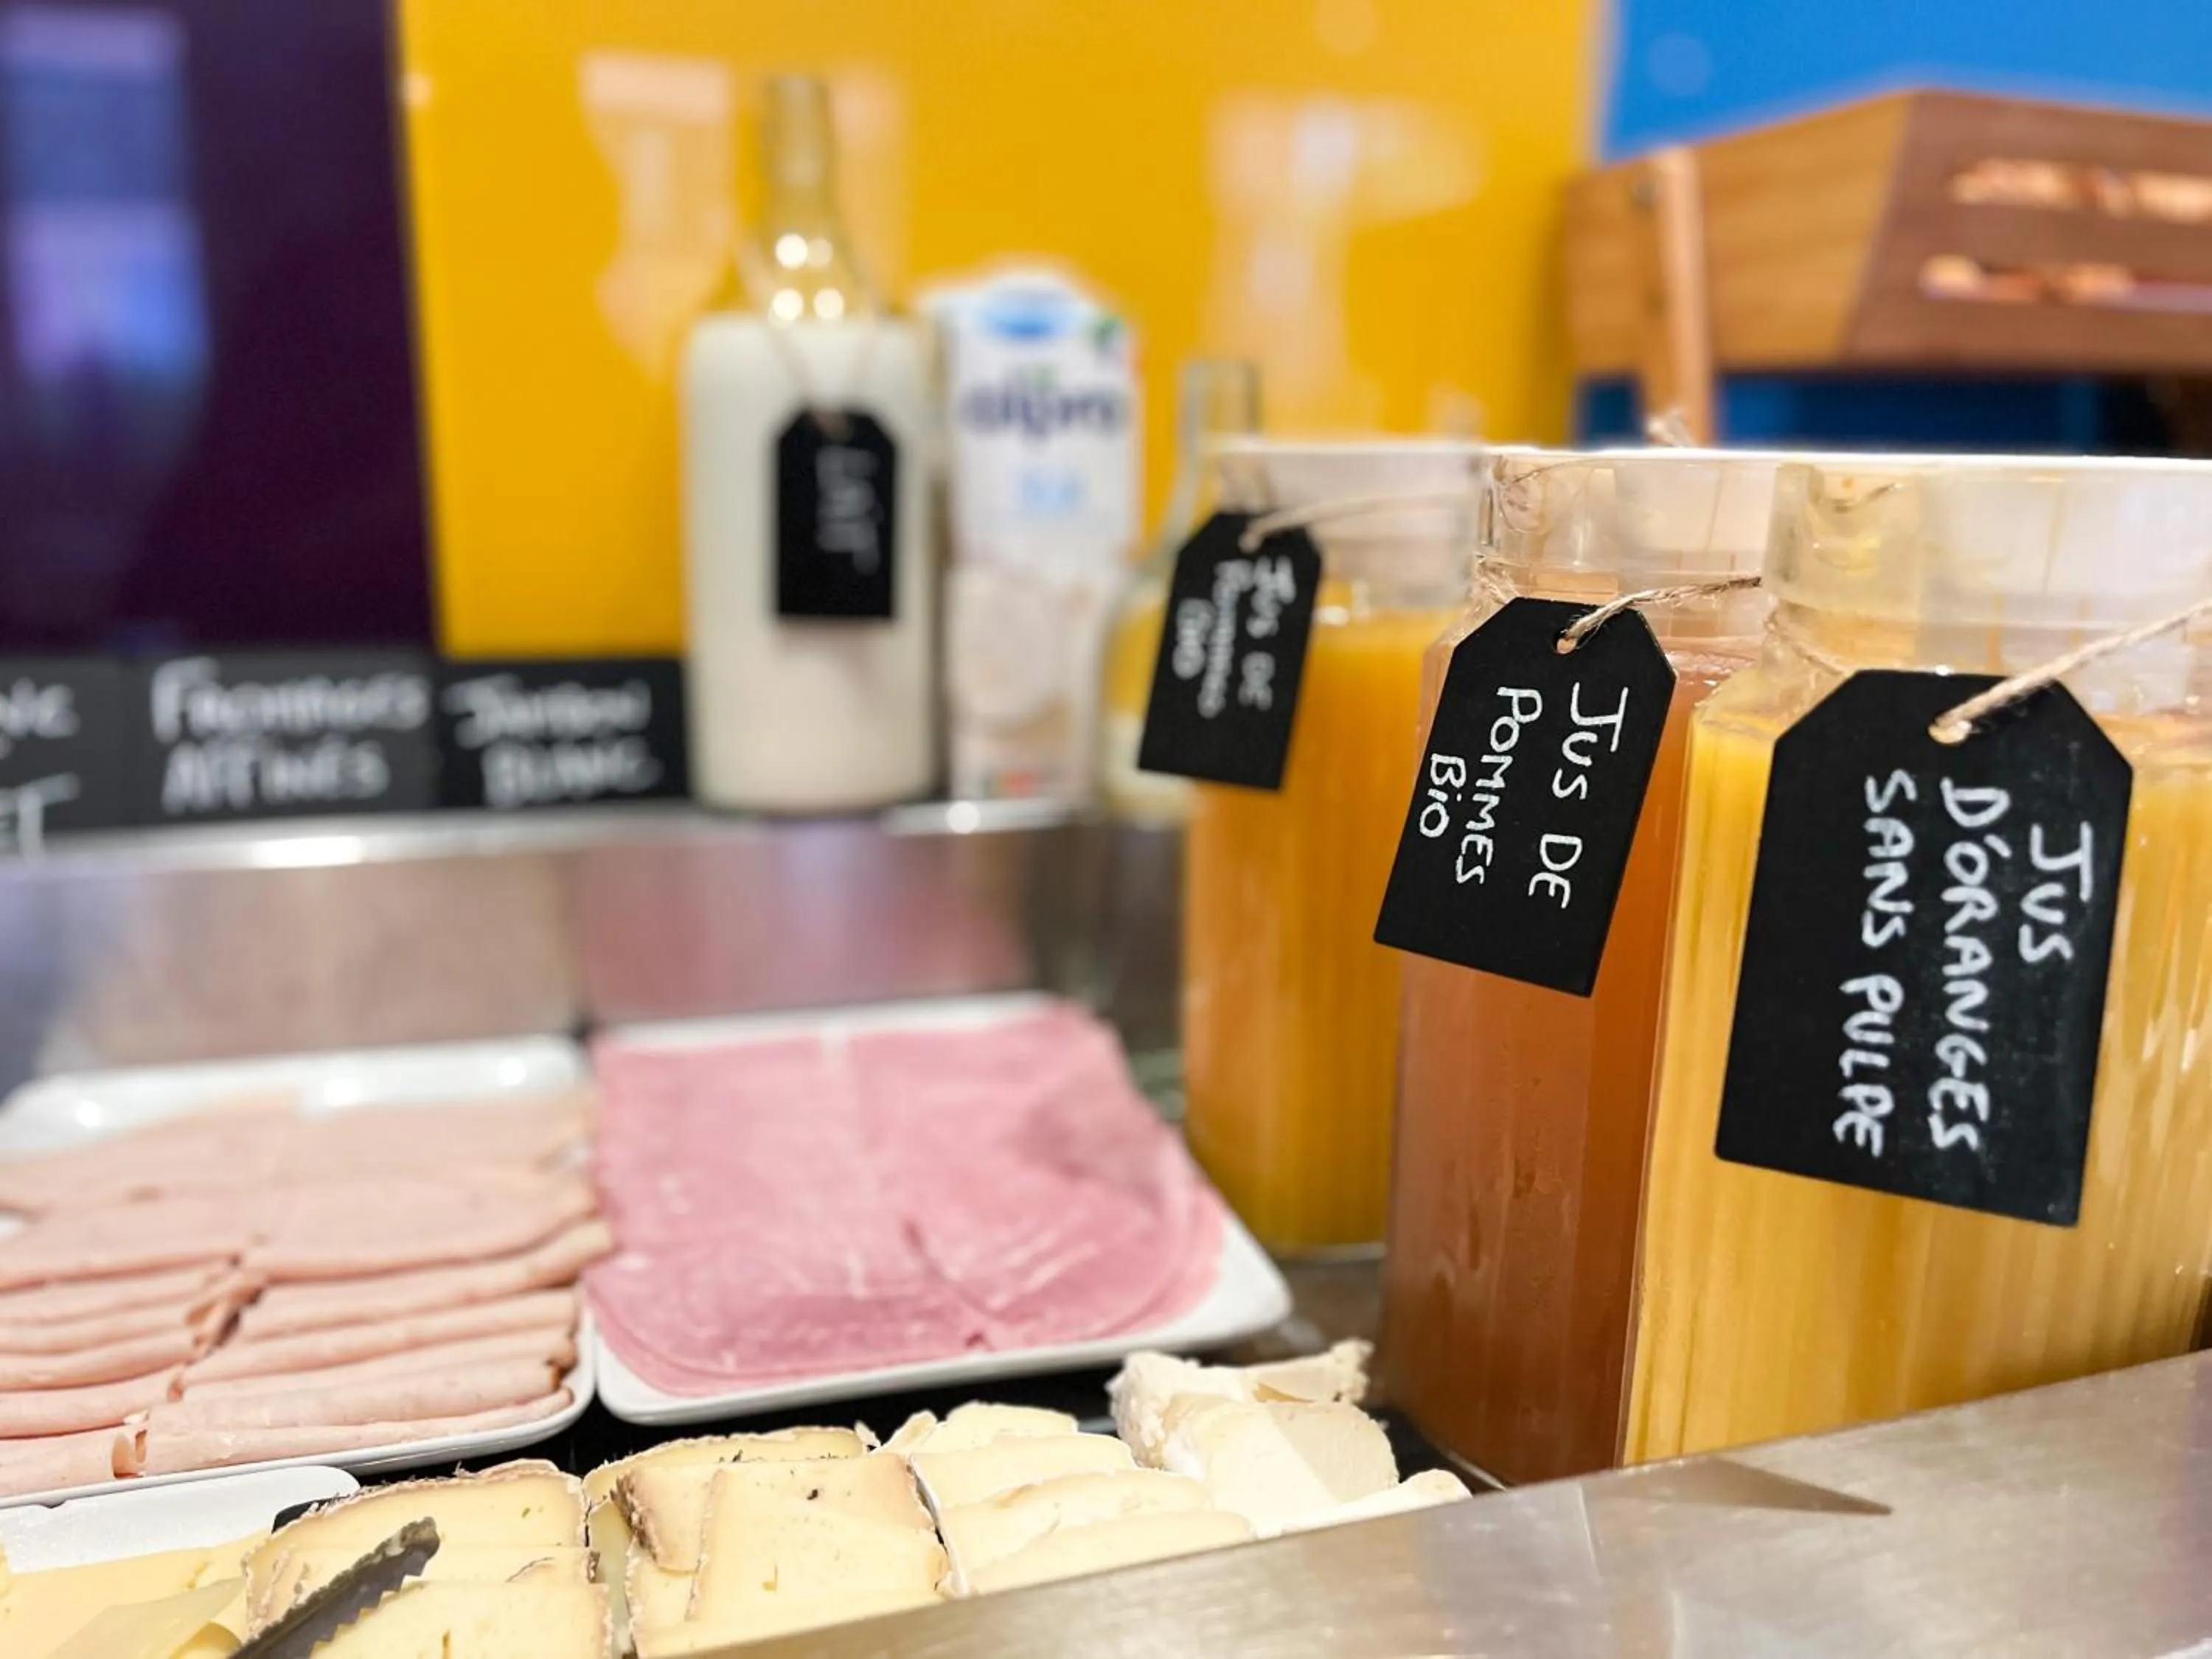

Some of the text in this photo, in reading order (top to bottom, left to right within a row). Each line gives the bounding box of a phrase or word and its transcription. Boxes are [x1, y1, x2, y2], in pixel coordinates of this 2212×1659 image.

[1238, 651, 1276, 712] DE
[1455, 686, 1543, 885] POMMES
[1528, 682, 1629, 909] JUS DE
[2018, 821, 2094, 963] JUS
[1832, 769, 1916, 1158] SANS PULPE
[1927, 776, 2011, 1152] D'ORANGES
